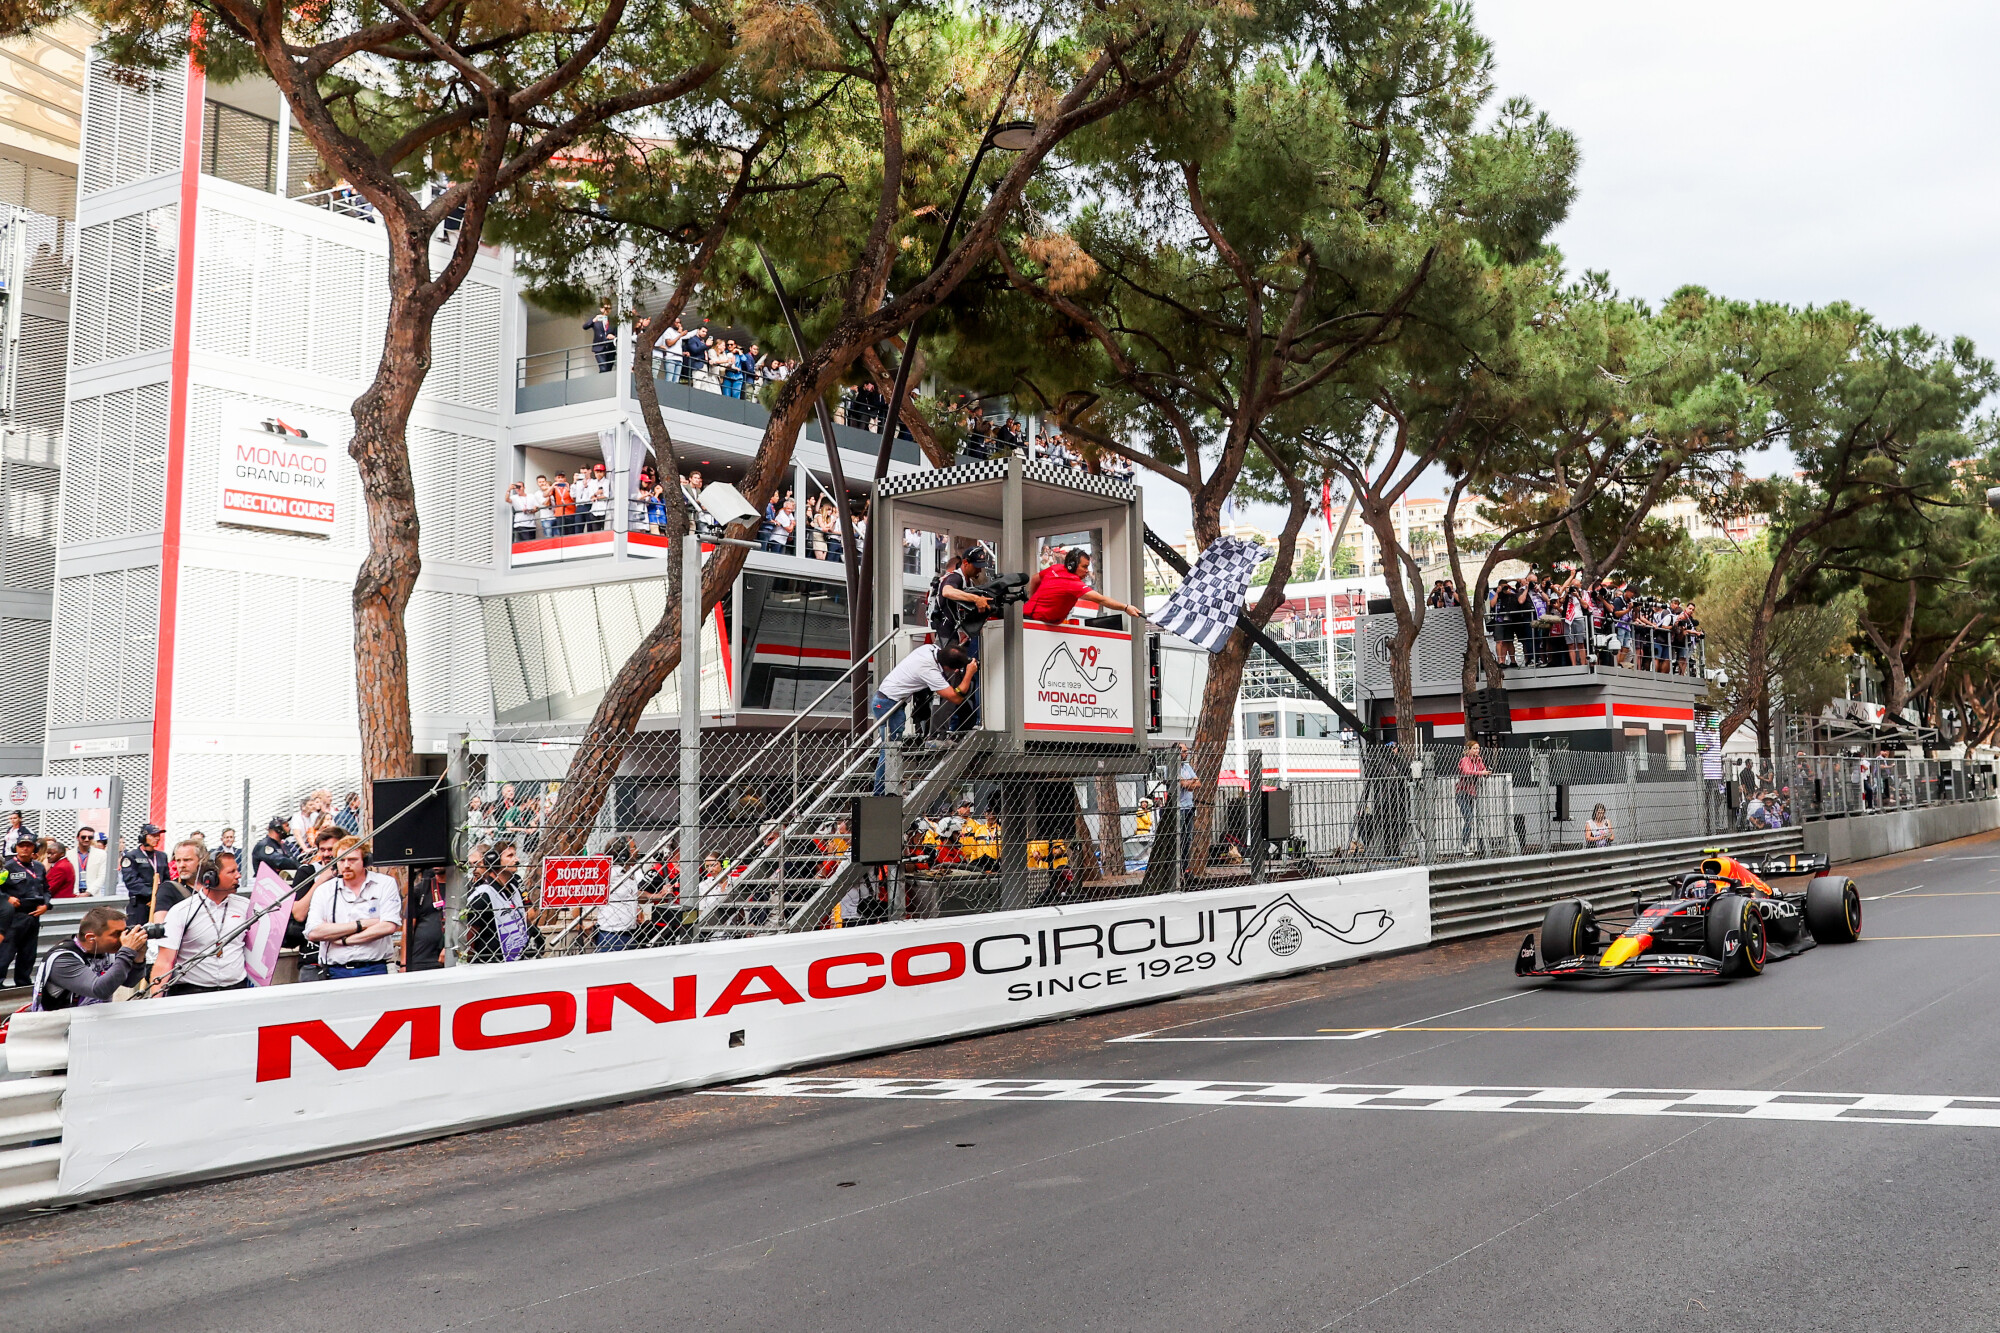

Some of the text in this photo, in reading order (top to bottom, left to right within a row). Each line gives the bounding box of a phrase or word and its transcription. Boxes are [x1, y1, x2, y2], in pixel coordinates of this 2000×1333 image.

[237, 445, 326, 473] MONACO
[236, 465, 326, 489] GRAND PRIX
[225, 492, 333, 519] DIRECTION COURSE
[1038, 691, 1096, 704] MONACO
[47, 787, 78, 800] HU 1
[557, 867, 599, 880] BOUCHE
[547, 883, 606, 898] D'INCENDIE
[1007, 950, 1216, 1002] SINCE 1929
[256, 905, 1257, 1083] MONACO CIRCUIT
